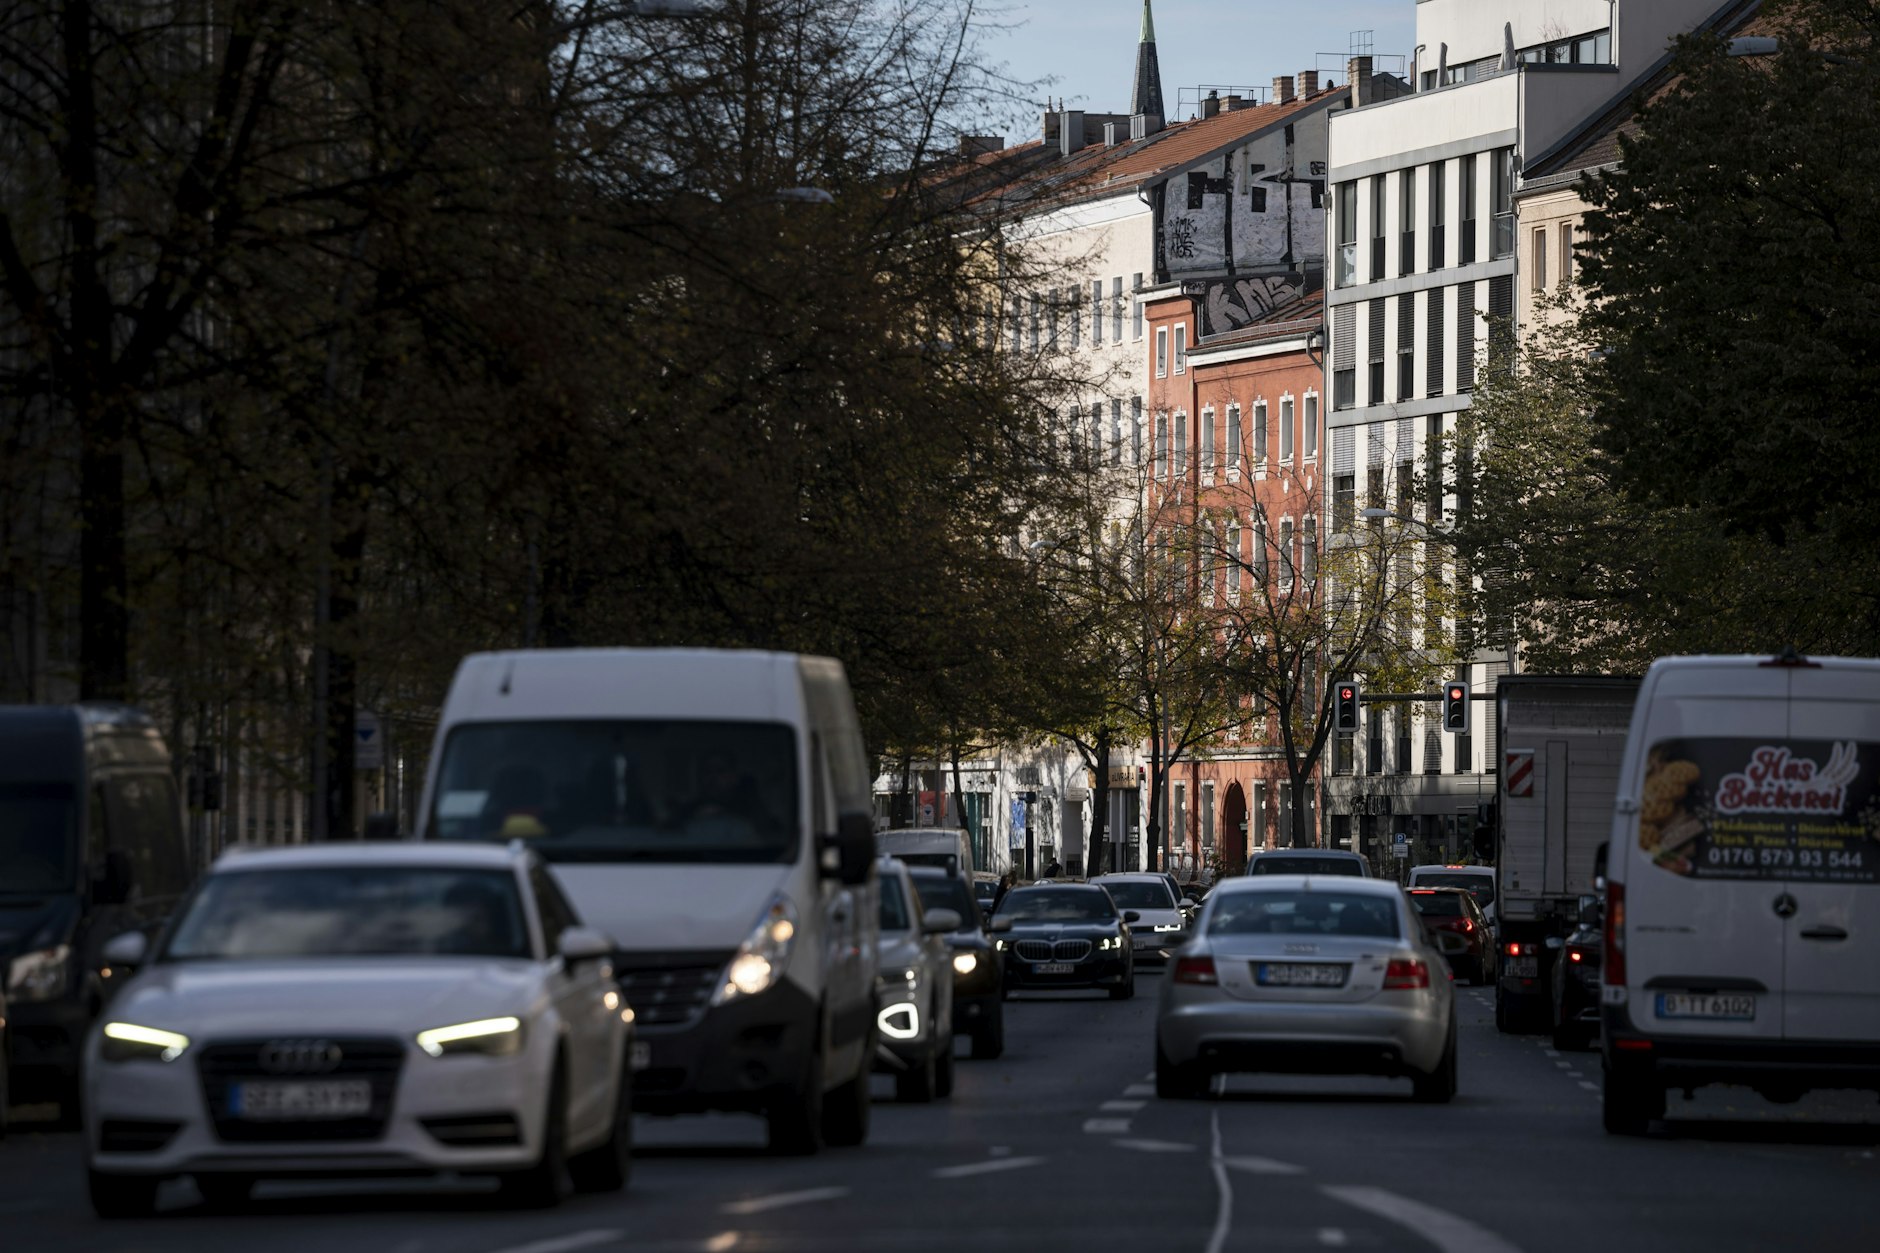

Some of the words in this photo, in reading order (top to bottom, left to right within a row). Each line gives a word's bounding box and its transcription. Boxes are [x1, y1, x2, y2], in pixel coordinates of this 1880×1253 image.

[1708, 847, 1754, 865] 0176
[1760, 849, 1794, 867] 579
[1799, 850, 1822, 867] 93
[1828, 851, 1862, 868] 544
[1667, 995, 1676, 1011] B
[1688, 995, 1709, 1012] TT
[1711, 997, 1751, 1014] 6102
